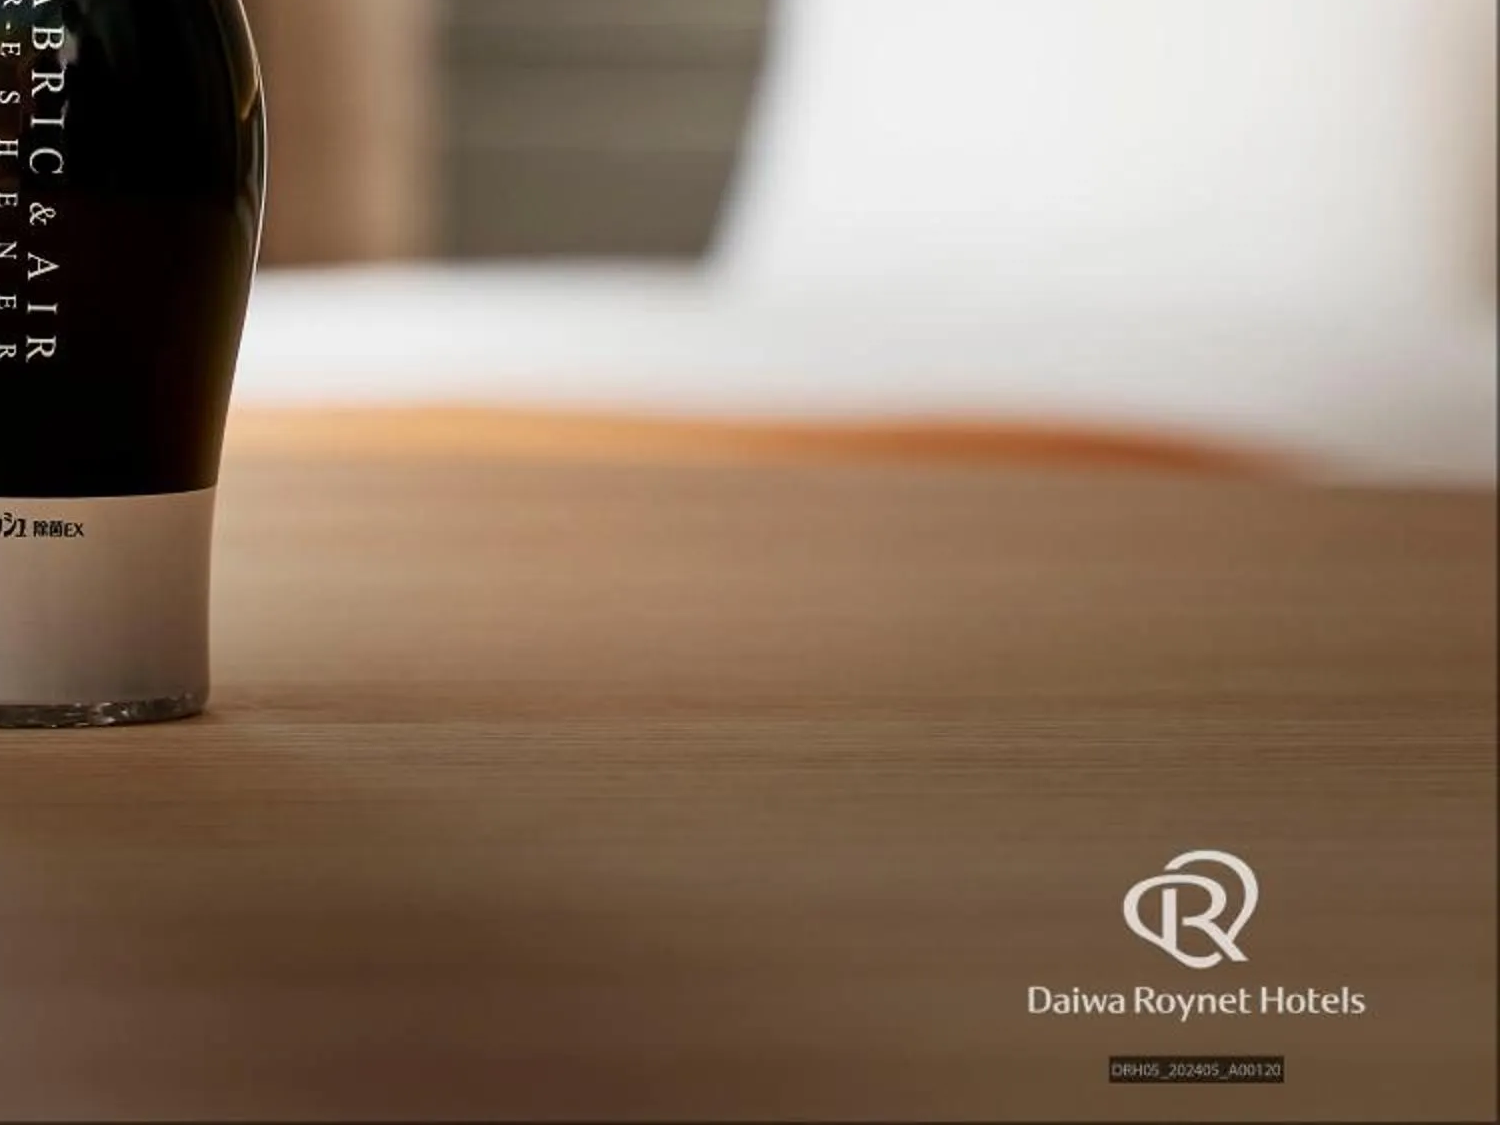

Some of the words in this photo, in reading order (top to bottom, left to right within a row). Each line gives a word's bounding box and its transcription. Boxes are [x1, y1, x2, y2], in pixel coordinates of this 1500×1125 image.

[29, 202, 57, 226] &
[26, 251, 60, 362] AIR
[33, 520, 85, 538] 除菌EX
